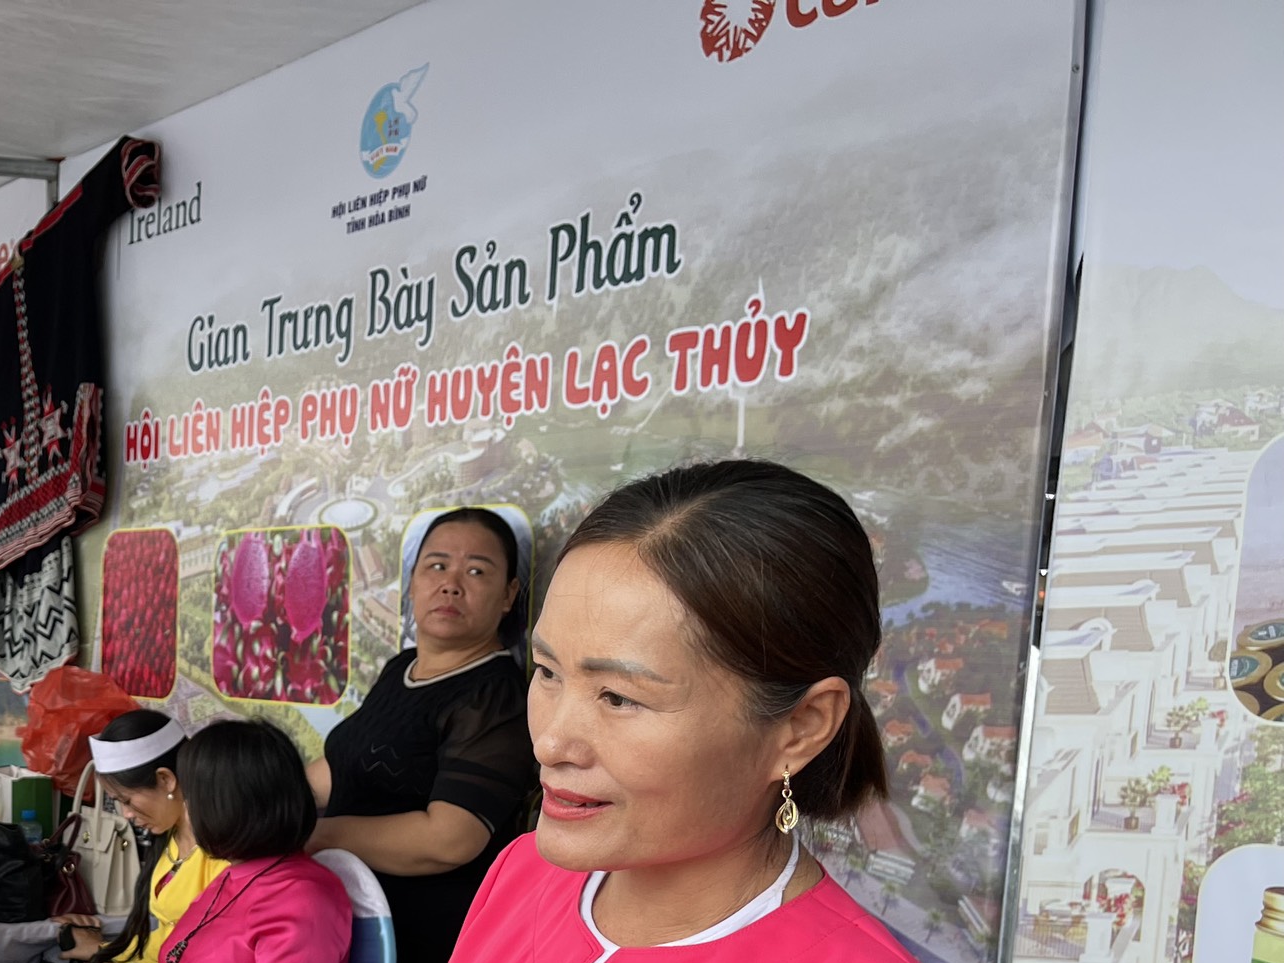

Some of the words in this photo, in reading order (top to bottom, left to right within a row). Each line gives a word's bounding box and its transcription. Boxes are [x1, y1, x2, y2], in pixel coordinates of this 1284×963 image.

[127, 183, 203, 246] Ireland
[188, 314, 249, 373] Gian
[261, 295, 352, 362] Trưng
[368, 267, 434, 346] Bày
[452, 241, 529, 317] Sản
[549, 192, 680, 300] Phẩm
[125, 410, 159, 464] HỘI
[167, 409, 217, 458] LIÊN
[231, 387, 290, 455] HIỆP
[299, 382, 359, 444] PHỤ
[370, 365, 418, 429] NỮ
[427, 346, 549, 425] HUYỆN
[564, 338, 649, 418] LẠC
[669, 299, 808, 393] THỦY
